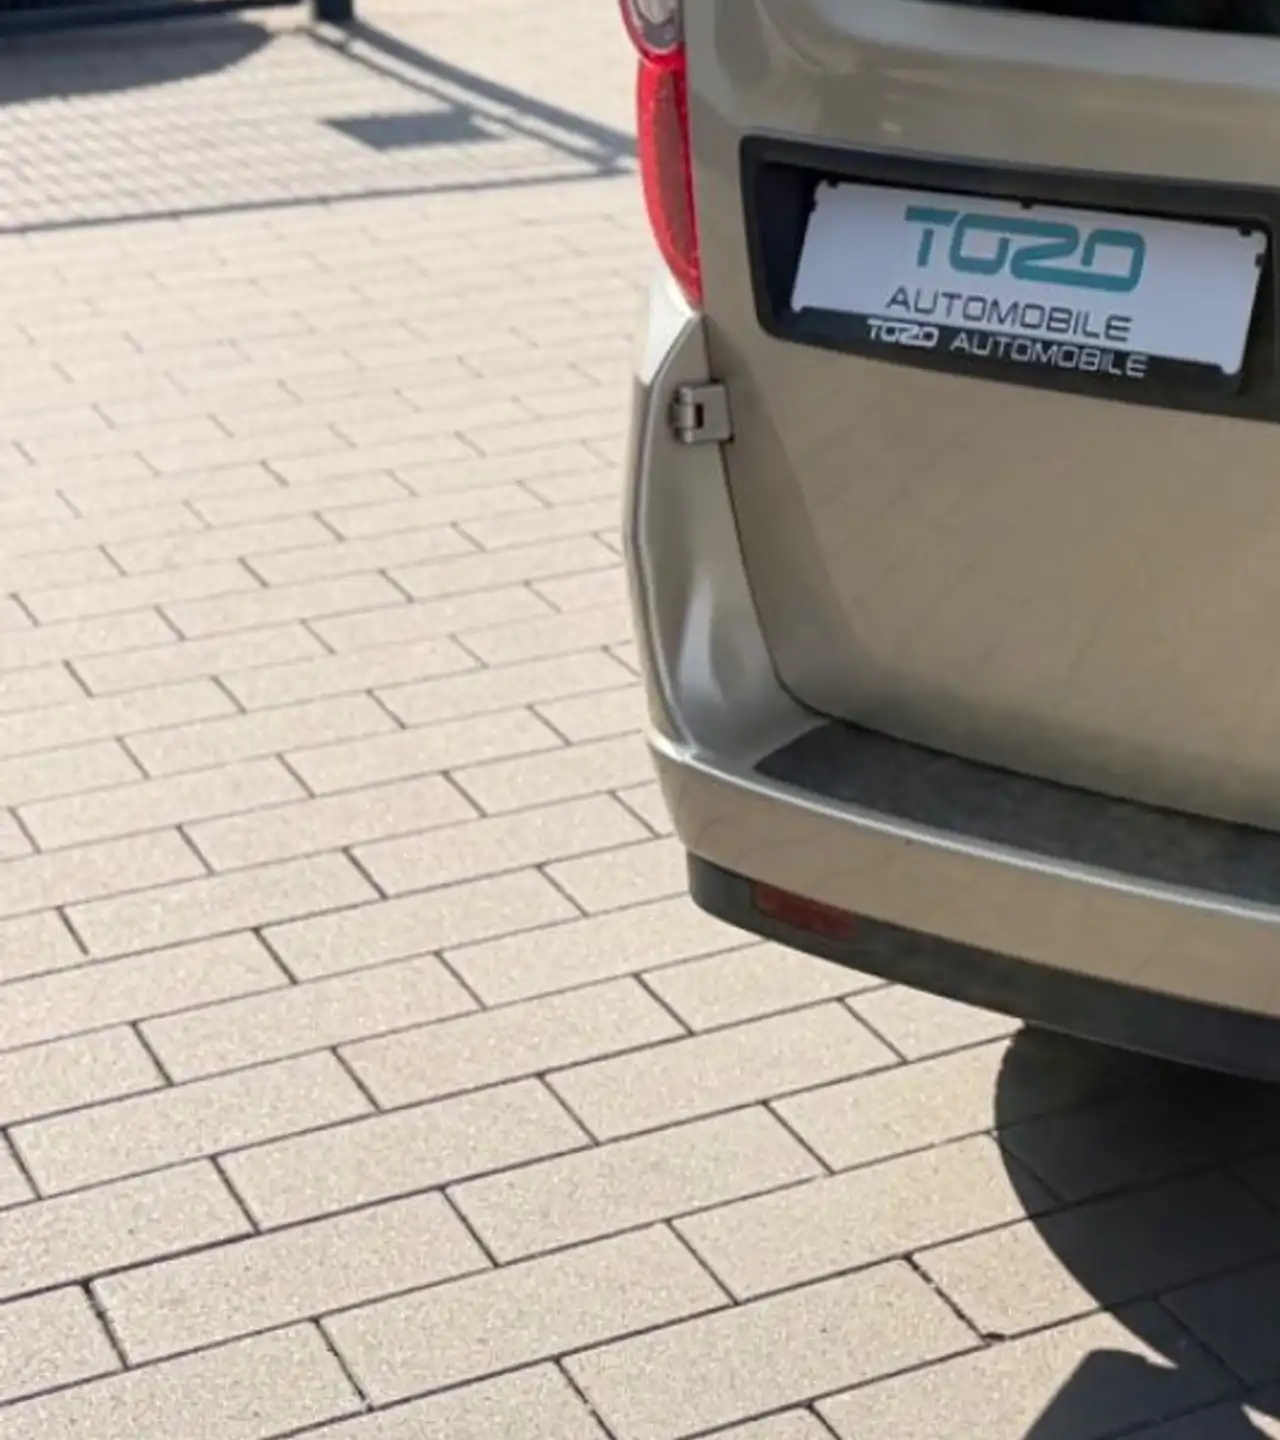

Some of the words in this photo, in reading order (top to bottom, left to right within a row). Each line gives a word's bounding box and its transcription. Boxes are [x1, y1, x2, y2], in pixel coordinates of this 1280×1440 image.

[885, 286, 1132, 343] AUTOMOBILE
[866, 317, 939, 347] TOZO
[950, 331, 1150, 377] AUTOMOBILE
